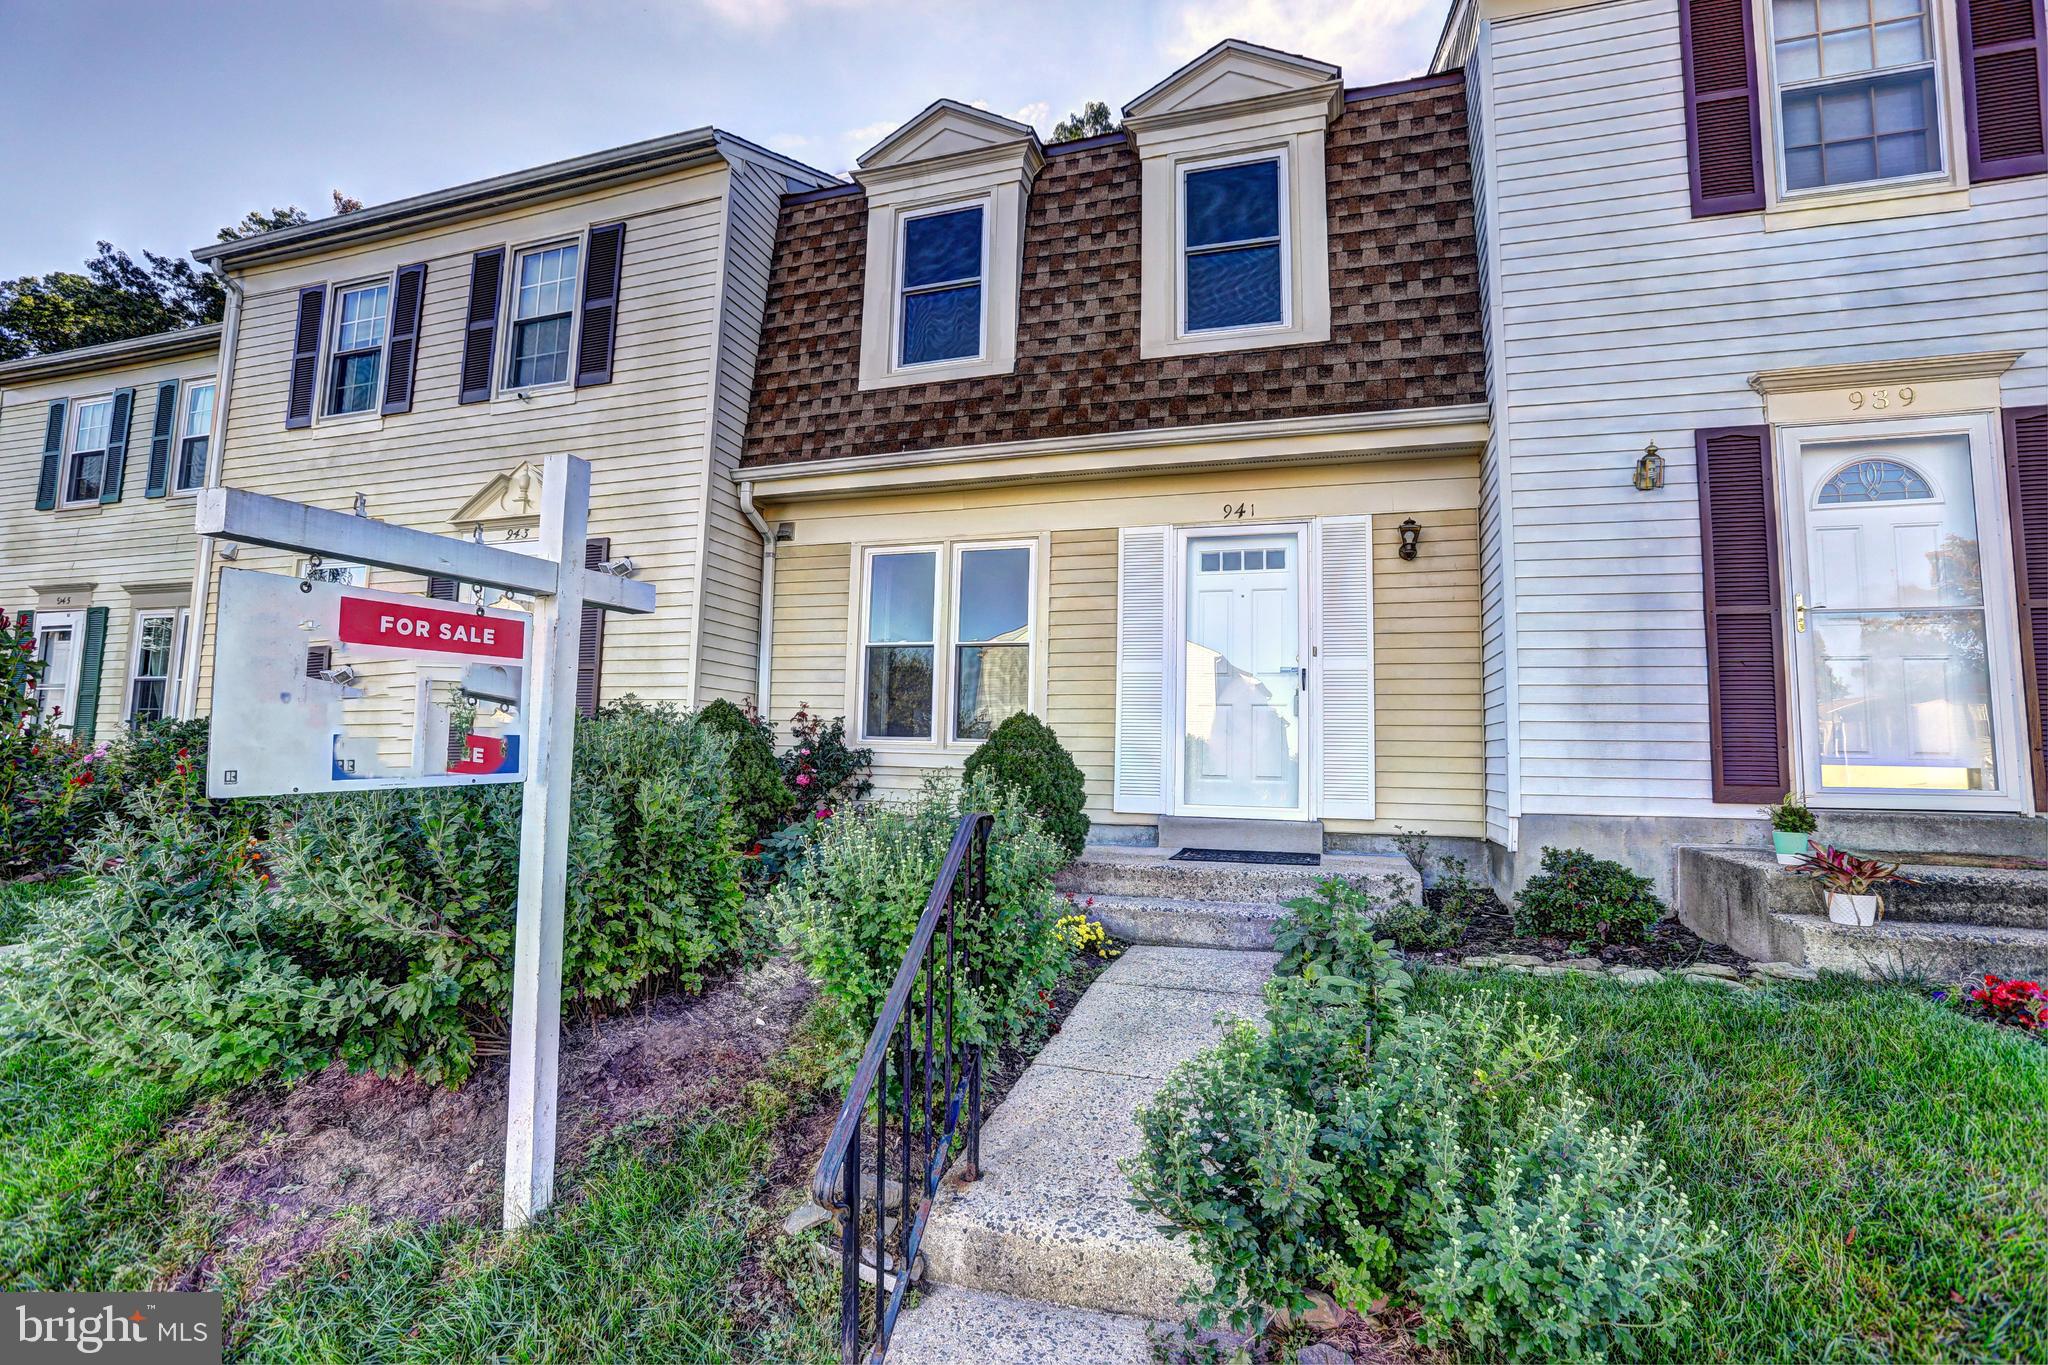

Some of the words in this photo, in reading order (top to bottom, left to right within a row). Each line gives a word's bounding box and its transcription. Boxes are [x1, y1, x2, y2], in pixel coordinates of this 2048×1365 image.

[1848, 387, 1914, 411] 939
[1223, 502, 1255, 520] 941
[505, 528, 530, 541] 943
[380, 615, 431, 638] FOR
[439, 623, 496, 645] SALE
